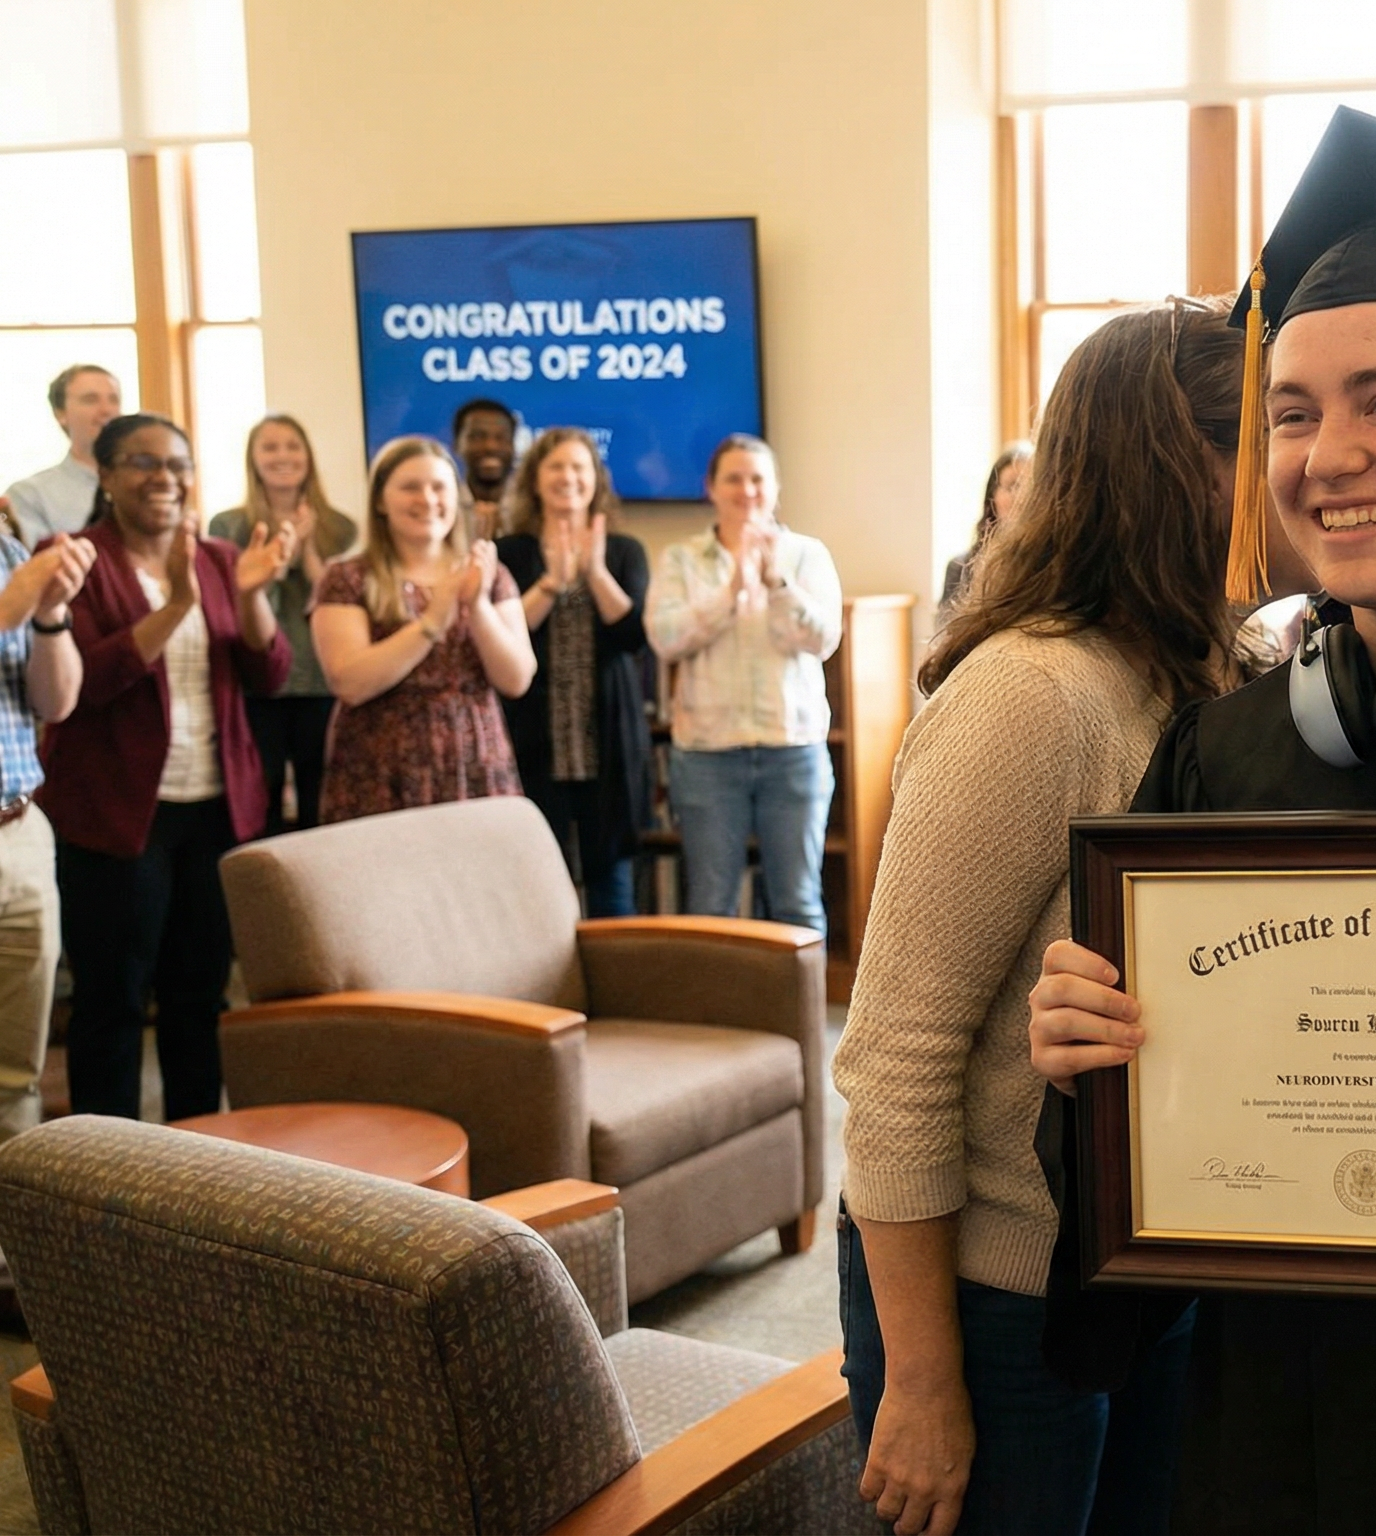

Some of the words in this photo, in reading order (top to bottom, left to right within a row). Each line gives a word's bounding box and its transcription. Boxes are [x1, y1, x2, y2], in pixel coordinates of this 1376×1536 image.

[383, 297, 726, 340] CONGRATULATIONS
[422, 347, 532, 382] CLASS
[540, 345, 591, 380] OF
[597, 343, 687, 379] 2024
[1189, 913, 1335, 976] Certificate
[1344, 907, 1371, 936] of
